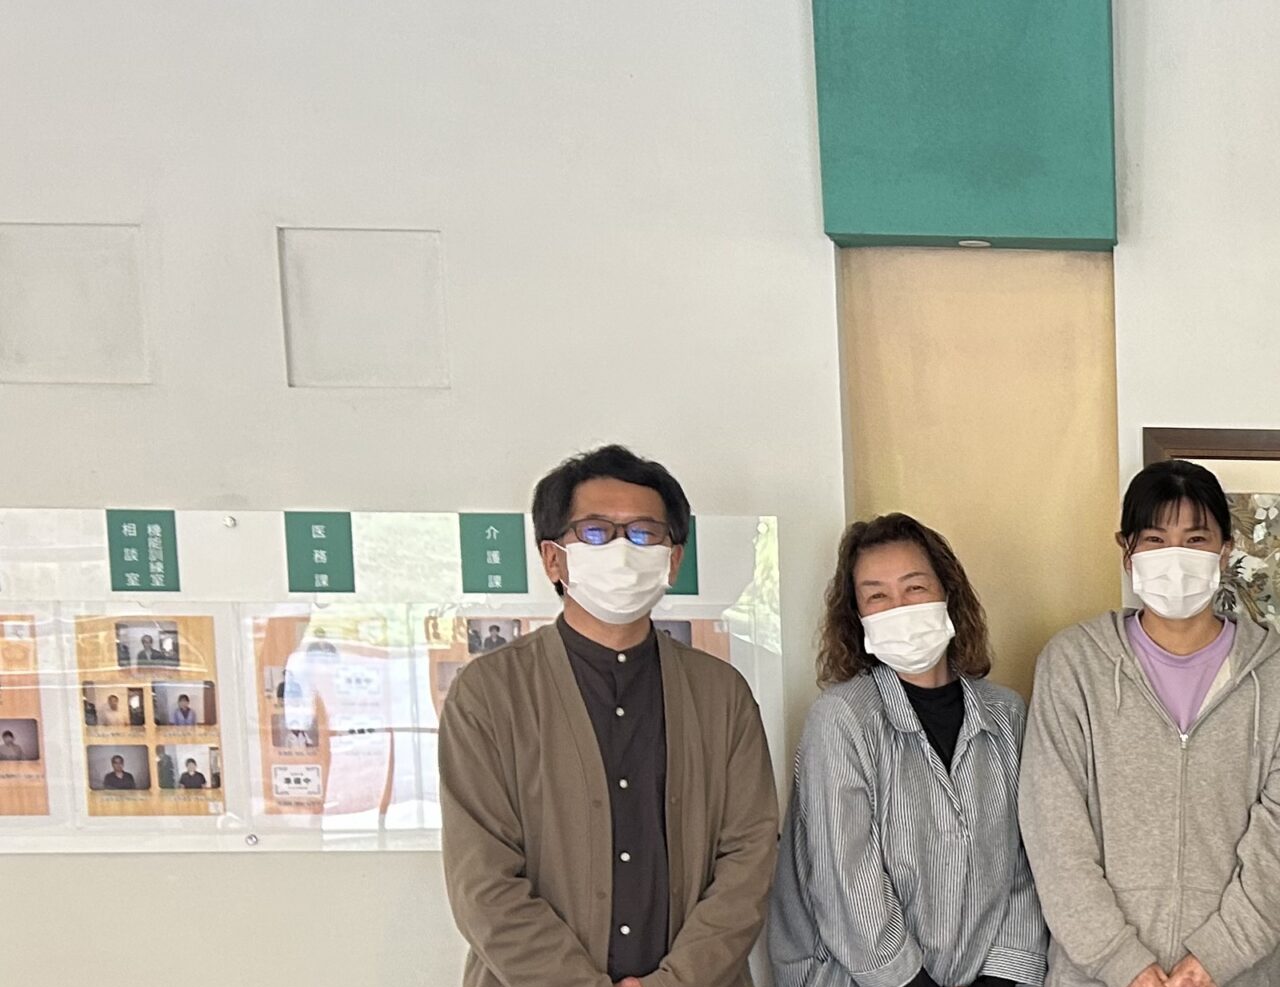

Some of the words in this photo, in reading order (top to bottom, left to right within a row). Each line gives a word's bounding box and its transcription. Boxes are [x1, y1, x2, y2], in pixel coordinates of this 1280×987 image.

[121, 522, 141, 587] 相談室
[311, 524, 329, 588] 医務課
[485, 525, 503, 589] 介護課
